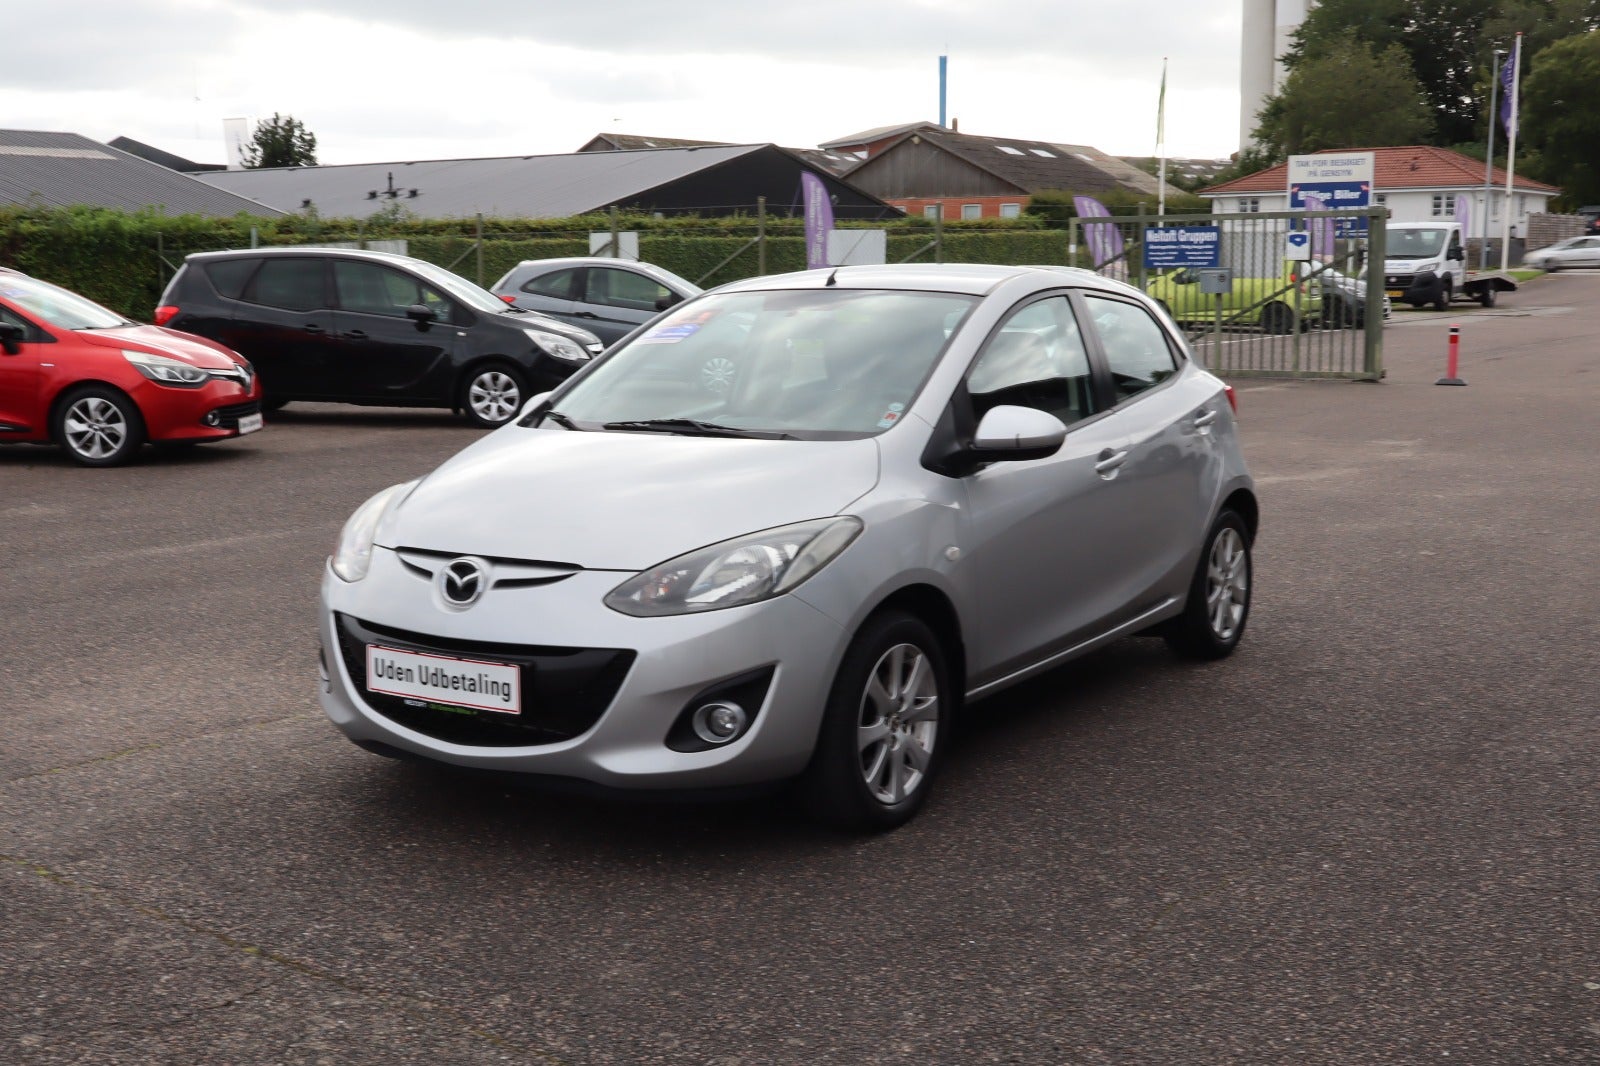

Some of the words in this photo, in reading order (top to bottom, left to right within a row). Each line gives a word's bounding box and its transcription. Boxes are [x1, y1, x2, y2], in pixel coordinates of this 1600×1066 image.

[1178, 229, 1217, 244] Gruppen
[374, 657, 414, 683] Uden
[418, 665, 511, 702] Udbetaling
